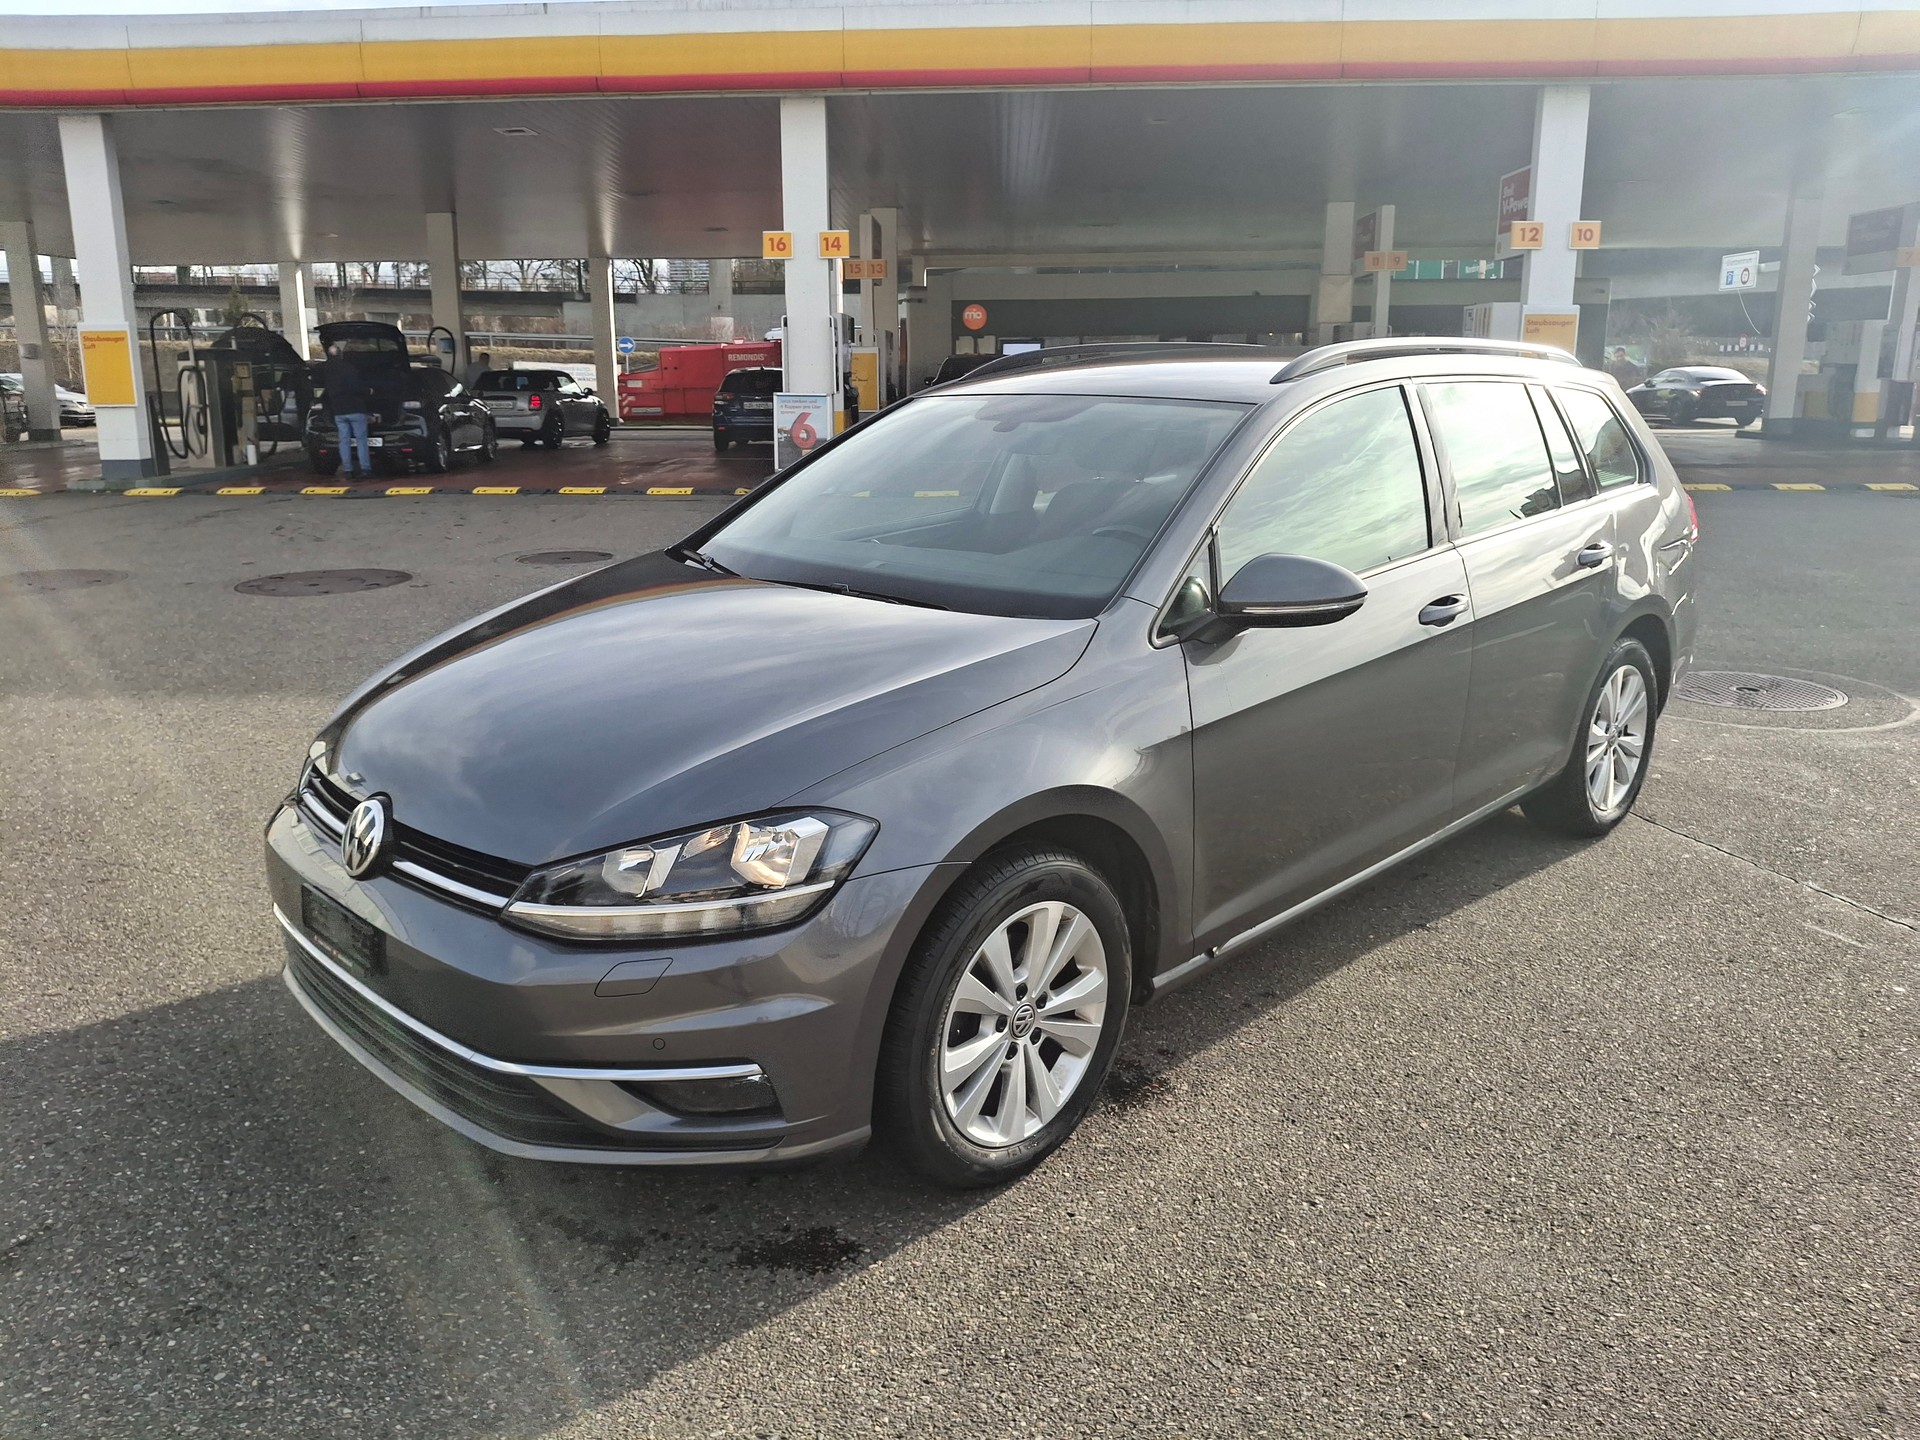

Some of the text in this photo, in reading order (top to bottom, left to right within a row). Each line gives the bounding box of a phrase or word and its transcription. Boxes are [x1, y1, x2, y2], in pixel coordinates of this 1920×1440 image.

[1503, 197, 1528, 215] V-Powe
[1520, 227, 1540, 242] 12
[1577, 228, 1594, 242] 10
[768, 237, 787, 252] 16
[823, 236, 842, 251] 14
[1395, 256, 1401, 266] 9
[849, 263, 862, 274] 15
[870, 263, 883, 274] 13
[728, 353, 765, 361] REMONDIS
[790, 412, 817, 449] 6
